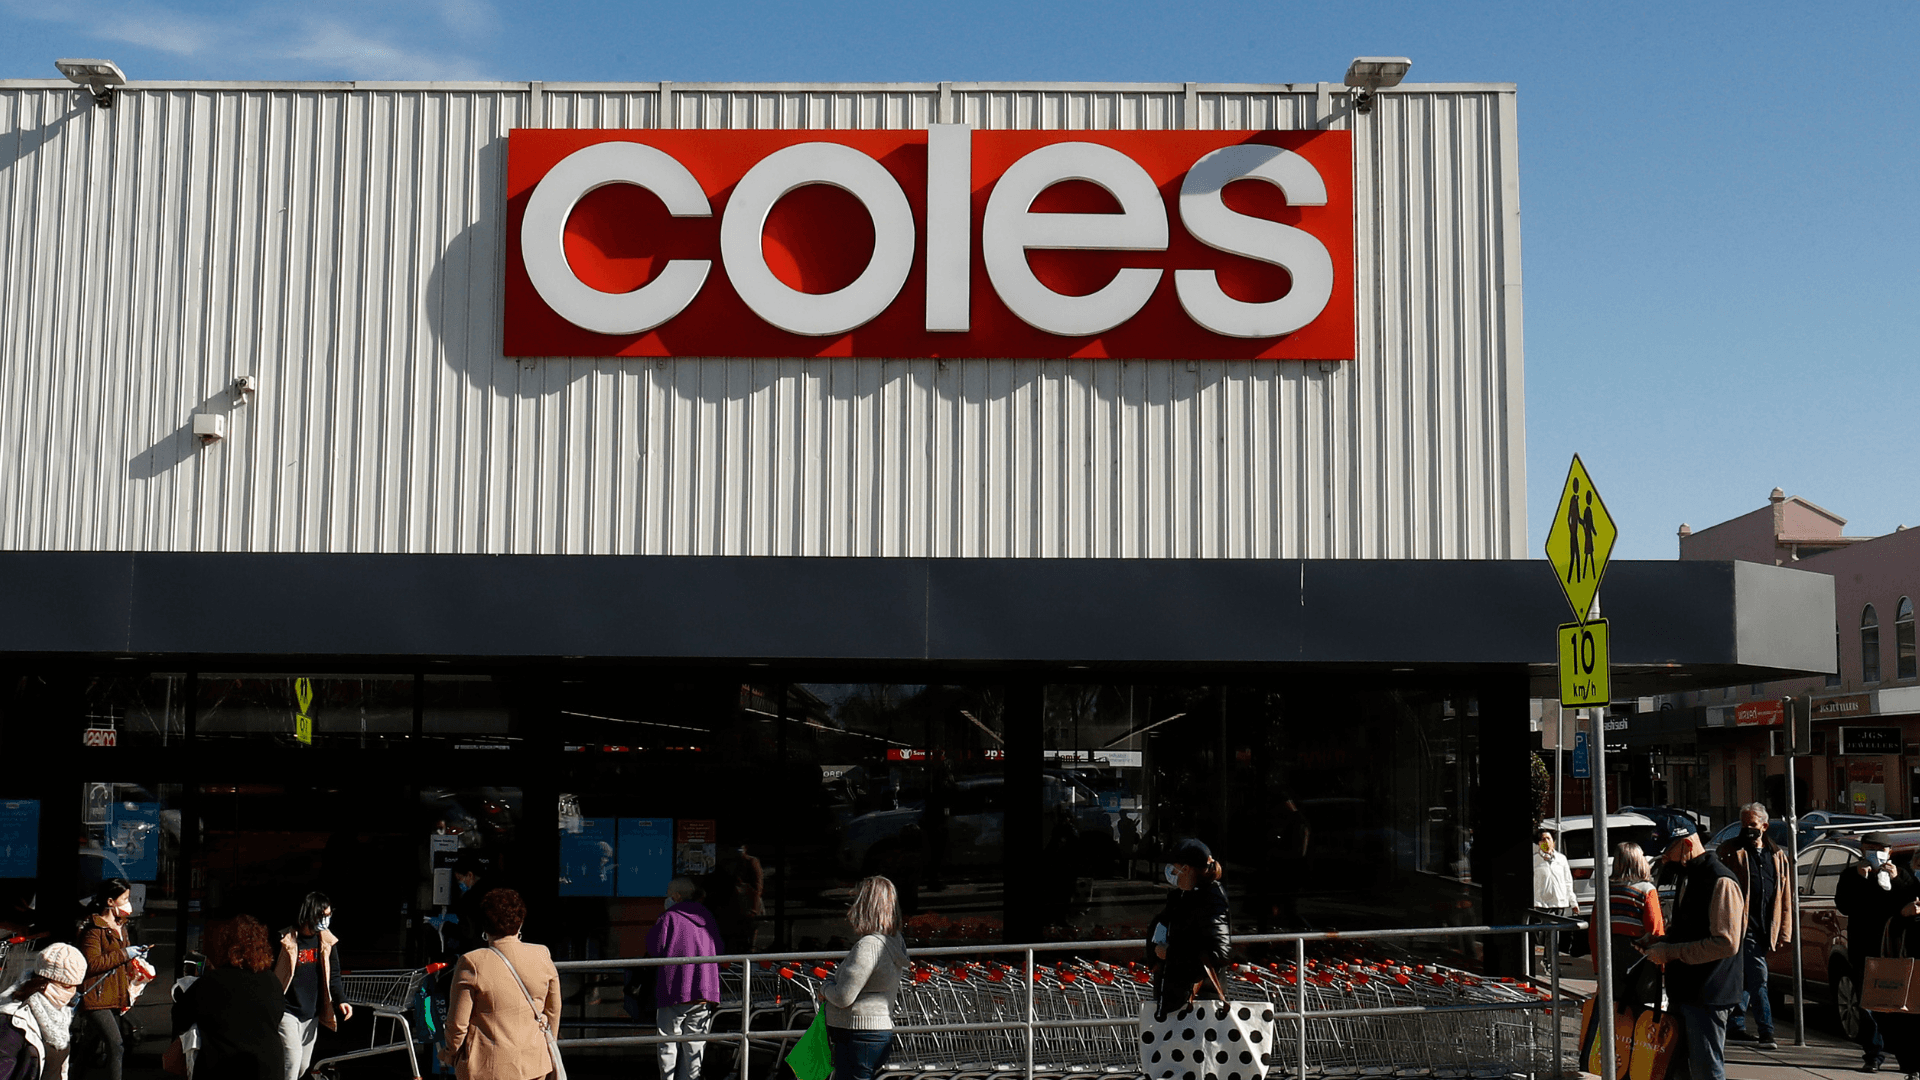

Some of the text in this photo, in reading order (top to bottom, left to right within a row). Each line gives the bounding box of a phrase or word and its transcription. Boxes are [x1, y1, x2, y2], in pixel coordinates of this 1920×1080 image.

[521, 124, 1335, 337] coles
[1571, 630, 1596, 676] 10
[1573, 679, 1597, 701] km/h
[1575, 735, 1584, 748] P
[1861, 731, 1884, 740] JGS
